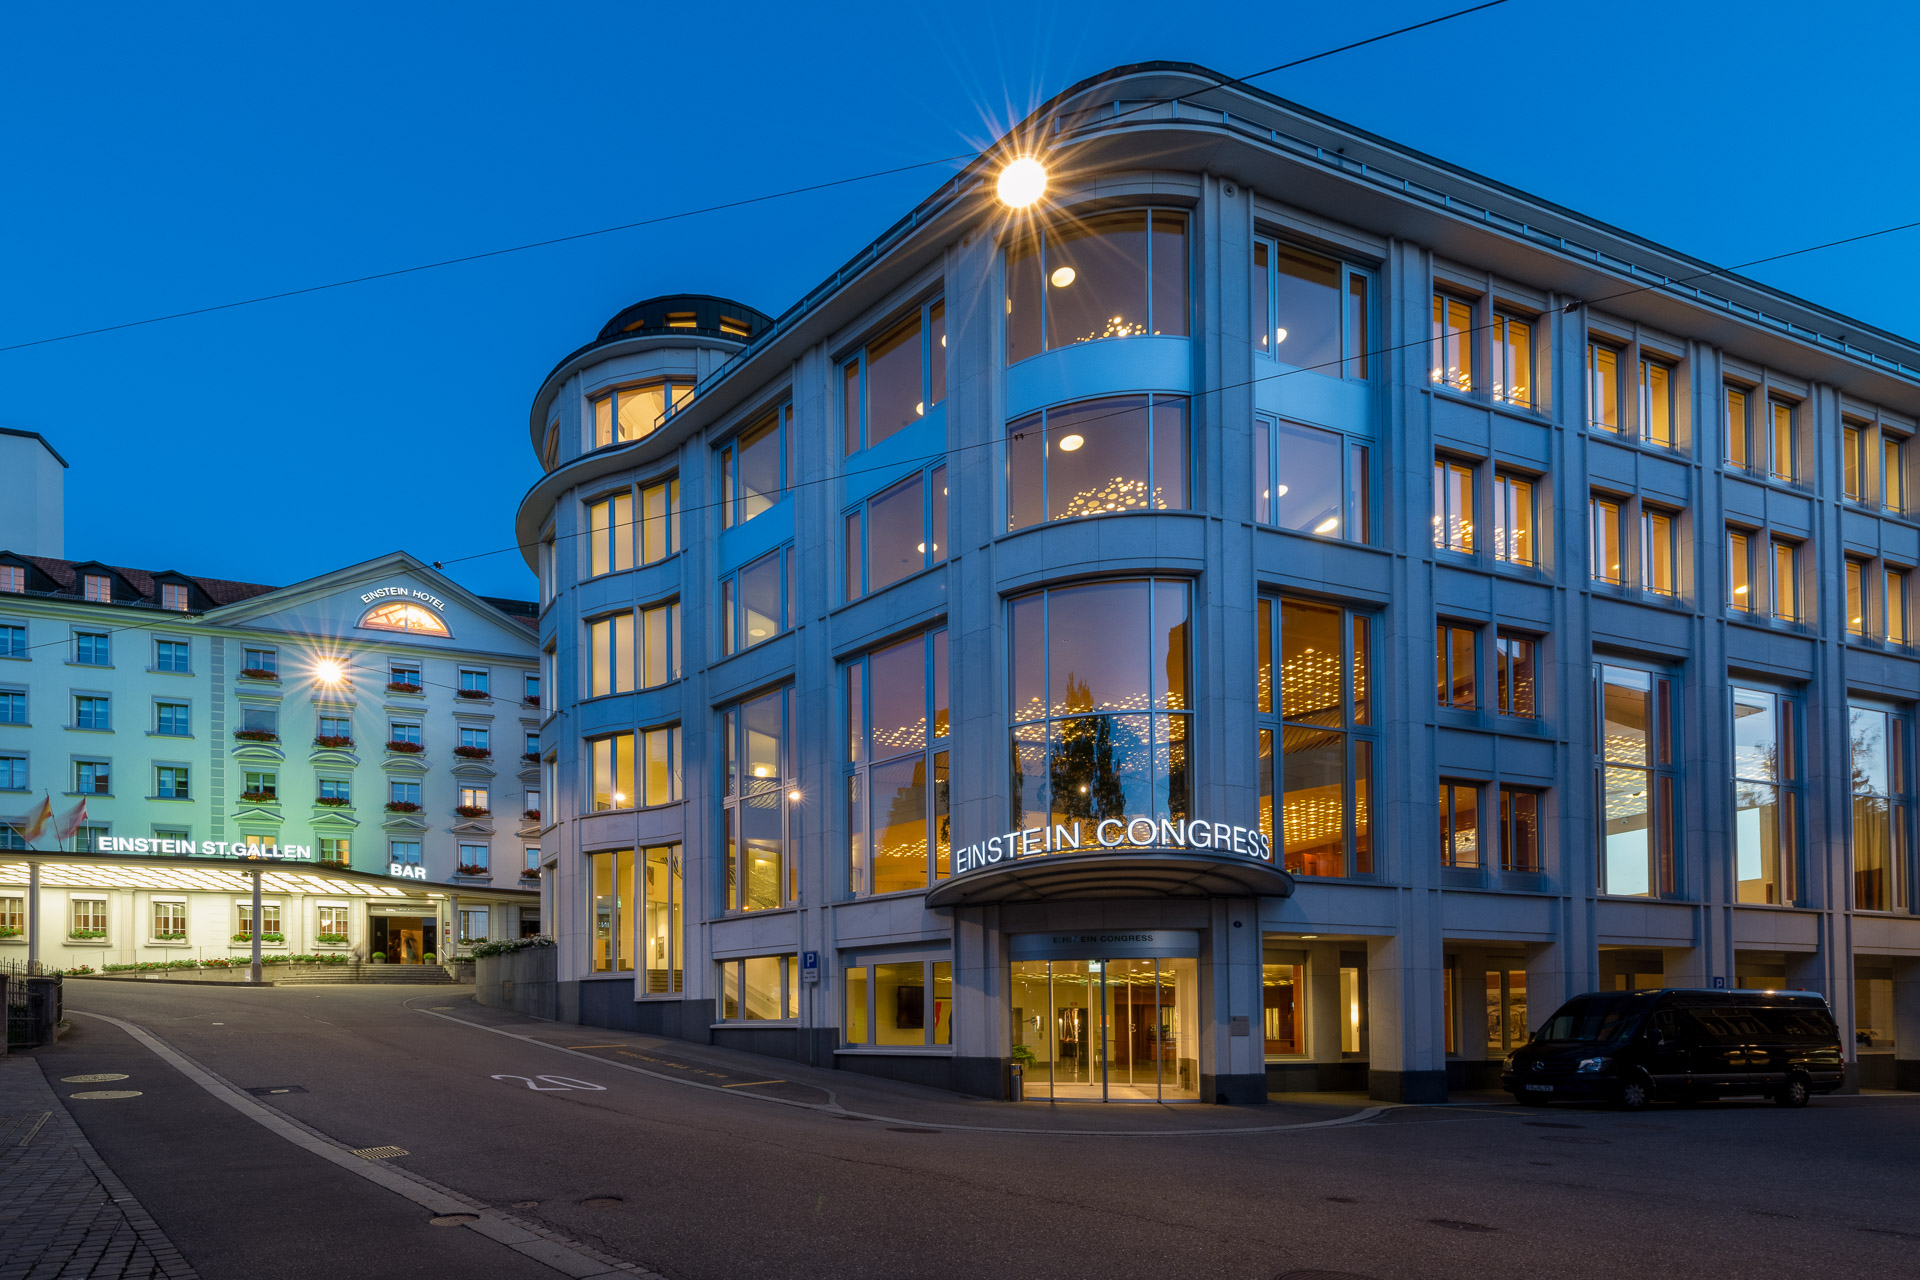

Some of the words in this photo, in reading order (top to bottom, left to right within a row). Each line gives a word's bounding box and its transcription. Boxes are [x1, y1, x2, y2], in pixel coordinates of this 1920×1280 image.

[360, 587, 408, 604] EINSTEIN
[412, 589, 446, 612] HOTEL
[98, 836, 196, 854] EINSTEIN
[201, 840, 311, 859] ST.GALLEN
[957, 821, 1081, 874] EINSTEIN
[1096, 817, 1271, 861] CONGRESS
[390, 863, 426, 880] BAR
[1100, 934, 1154, 942] CONGRESS
[806, 953, 815, 967] P
[1716, 978, 1723, 989] P
[490, 1074, 607, 1091] 20
